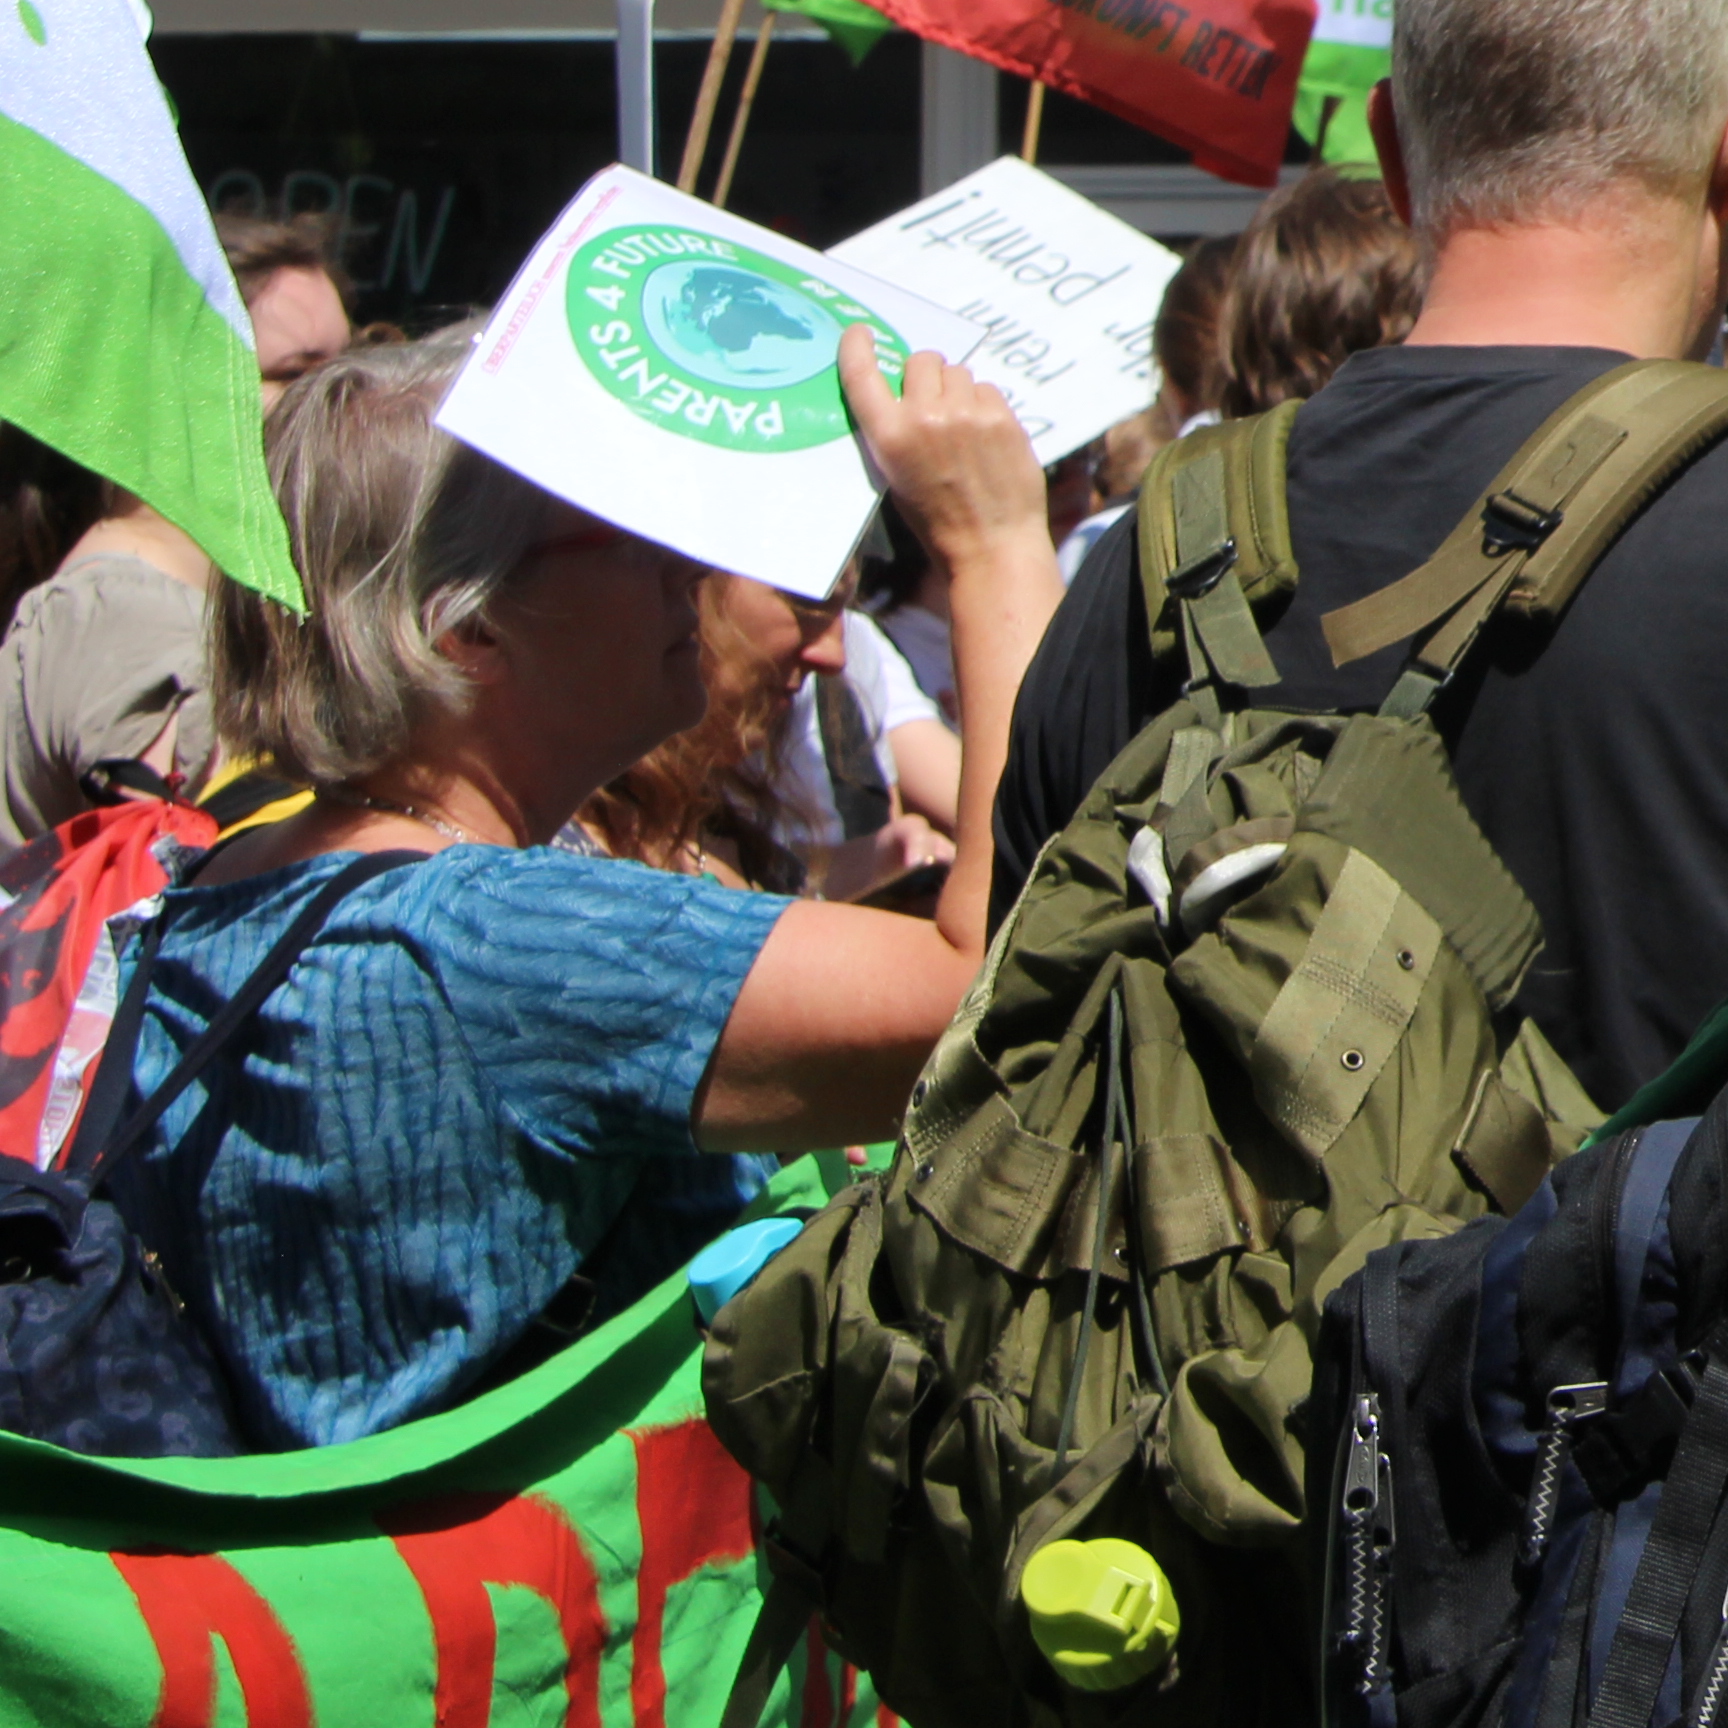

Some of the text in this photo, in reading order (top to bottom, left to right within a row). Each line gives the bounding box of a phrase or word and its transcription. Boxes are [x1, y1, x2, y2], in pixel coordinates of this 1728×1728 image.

[588, 232, 784, 438] PARENTS 4 FUTURE
